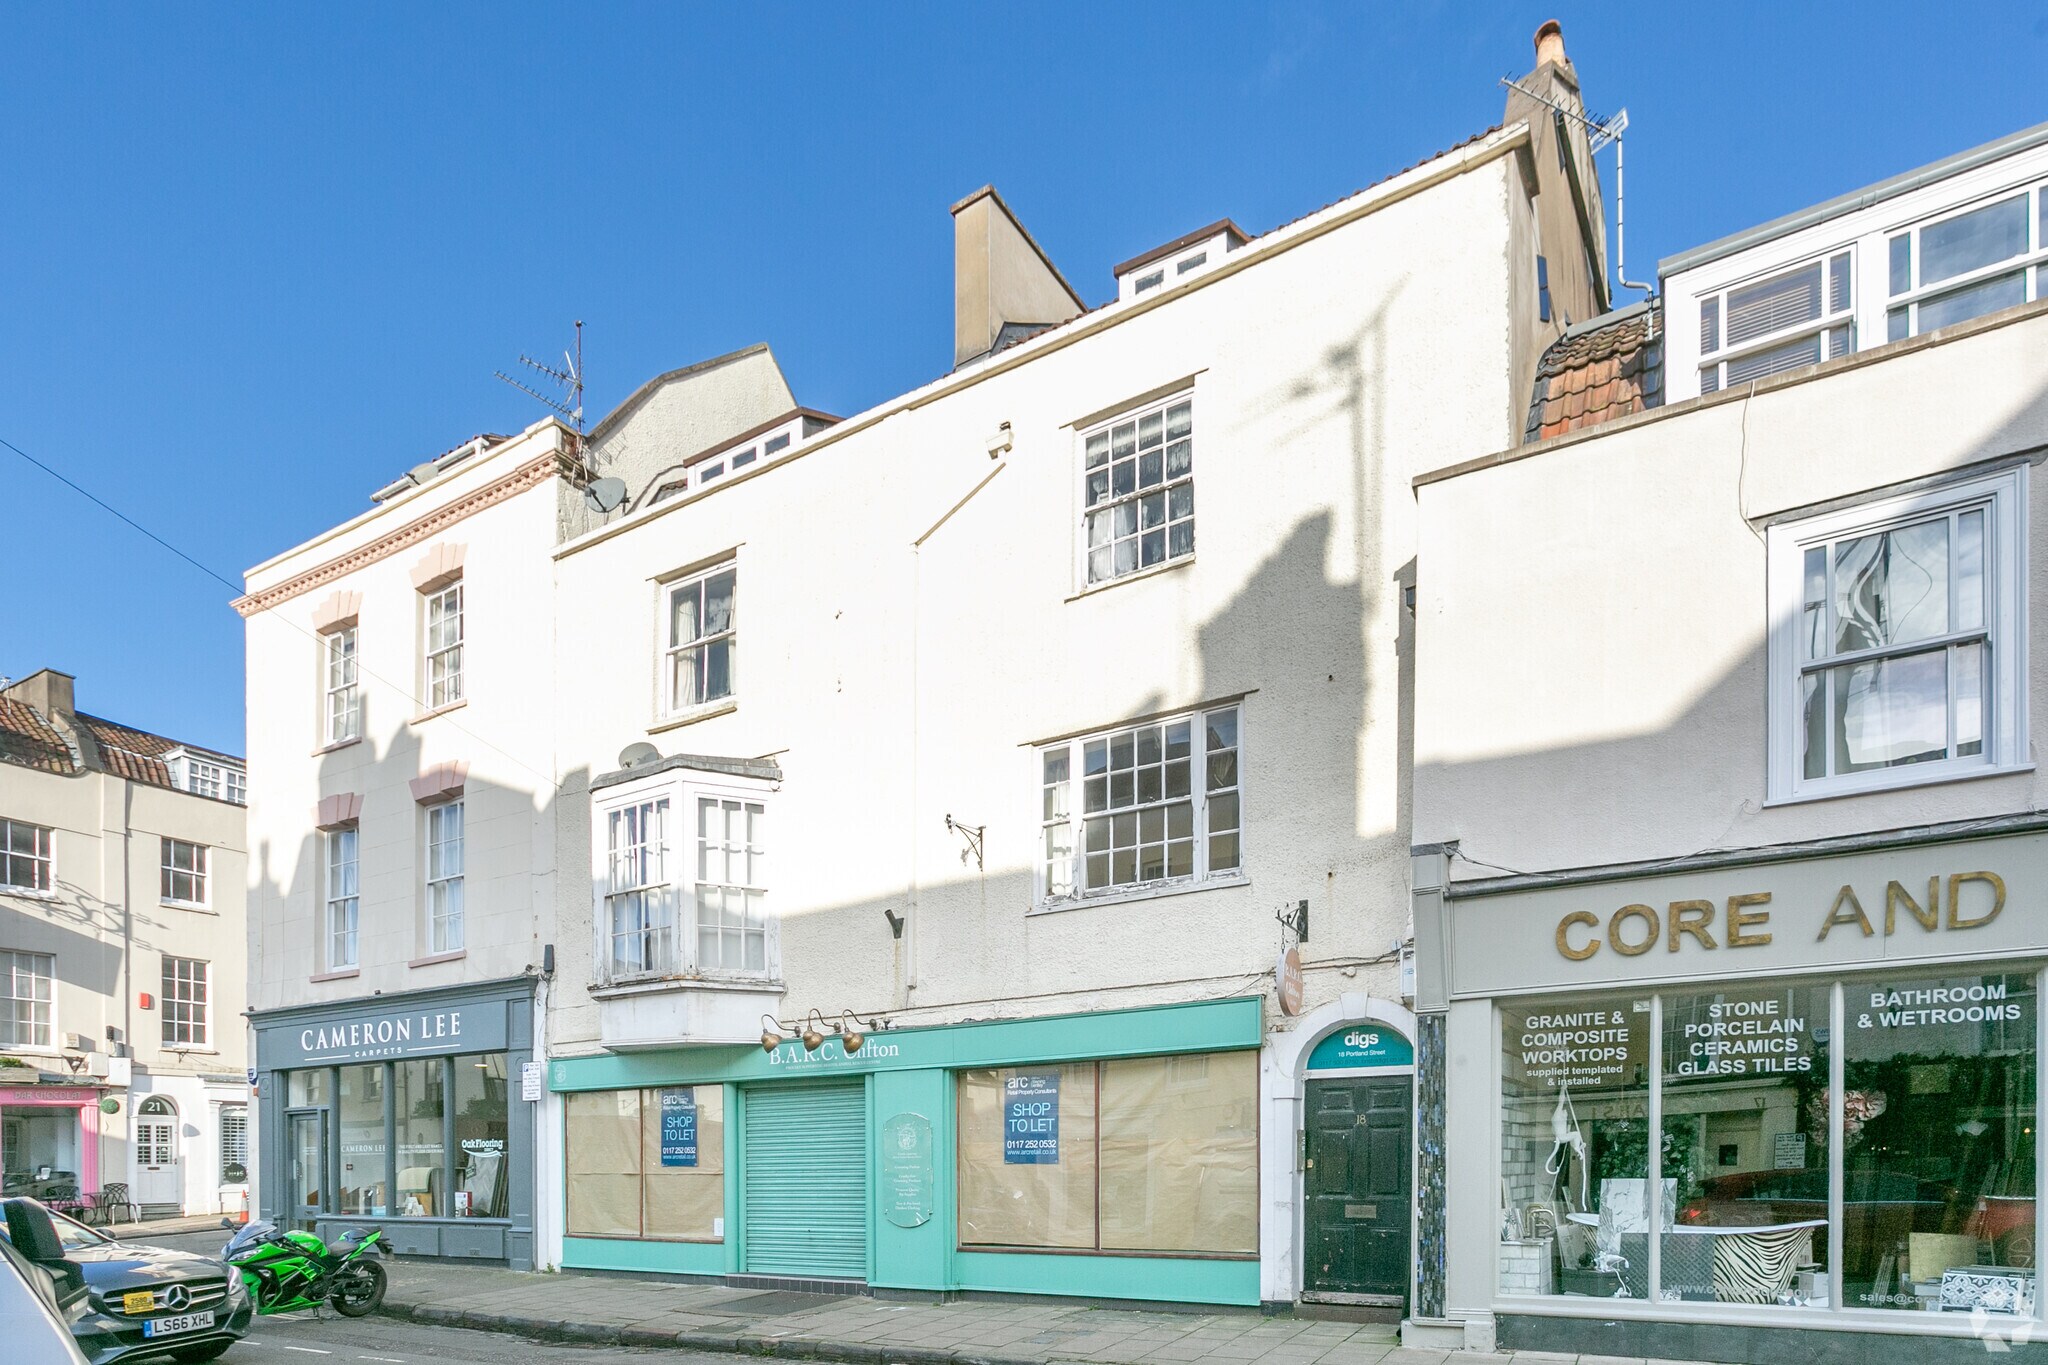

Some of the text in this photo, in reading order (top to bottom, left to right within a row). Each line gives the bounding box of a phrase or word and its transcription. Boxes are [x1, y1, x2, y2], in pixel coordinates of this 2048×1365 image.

[1555, 870, 2008, 961] CORE AND
[1870, 984, 2006, 1008] BATHROOM
[1709, 1000, 1778, 1018] STONE
[1857, 1004, 2021, 1028] & WETROOMS
[1526, 1011, 1624, 1029] GRANITE &
[301, 1012, 461, 1051] CAMERON LEE
[1684, 1018, 1804, 1038] PORCELAIN
[1344, 1032, 1378, 1048] digs
[1522, 1028, 1629, 1046] COMPOSITE
[354, 1047, 402, 1058] CARPETS
[1690, 1038, 1798, 1056] CERAMICS
[1522, 1048, 1628, 1064] WORKTOPS
[1526, 1064, 1623, 1077] supplied templated
[1678, 1056, 1812, 1075] GLASS TILES
[1008, 1076, 1028, 1088] arc
[1558, 1076, 1601, 1085] installed
[663, 1095, 677, 1104] arc
[147, 1102, 160, 1112] 21
[1013, 1103, 1050, 1116] SHOP
[666, 1116, 692, 1127] SHOP
[1009, 1118, 1055, 1132] TO LET
[1356, 1114, 1366, 1125] 18
[664, 1129, 695, 1140] TO LET
[341, 1144, 372, 1152] CAMERON
[462, 1139, 503, 1149] Oak Flooring
[1025, 1140, 1038, 1148] 252
[1039, 1140, 1056, 1148] 0532
[154, 1314, 212, 1333] LS66 XHL
